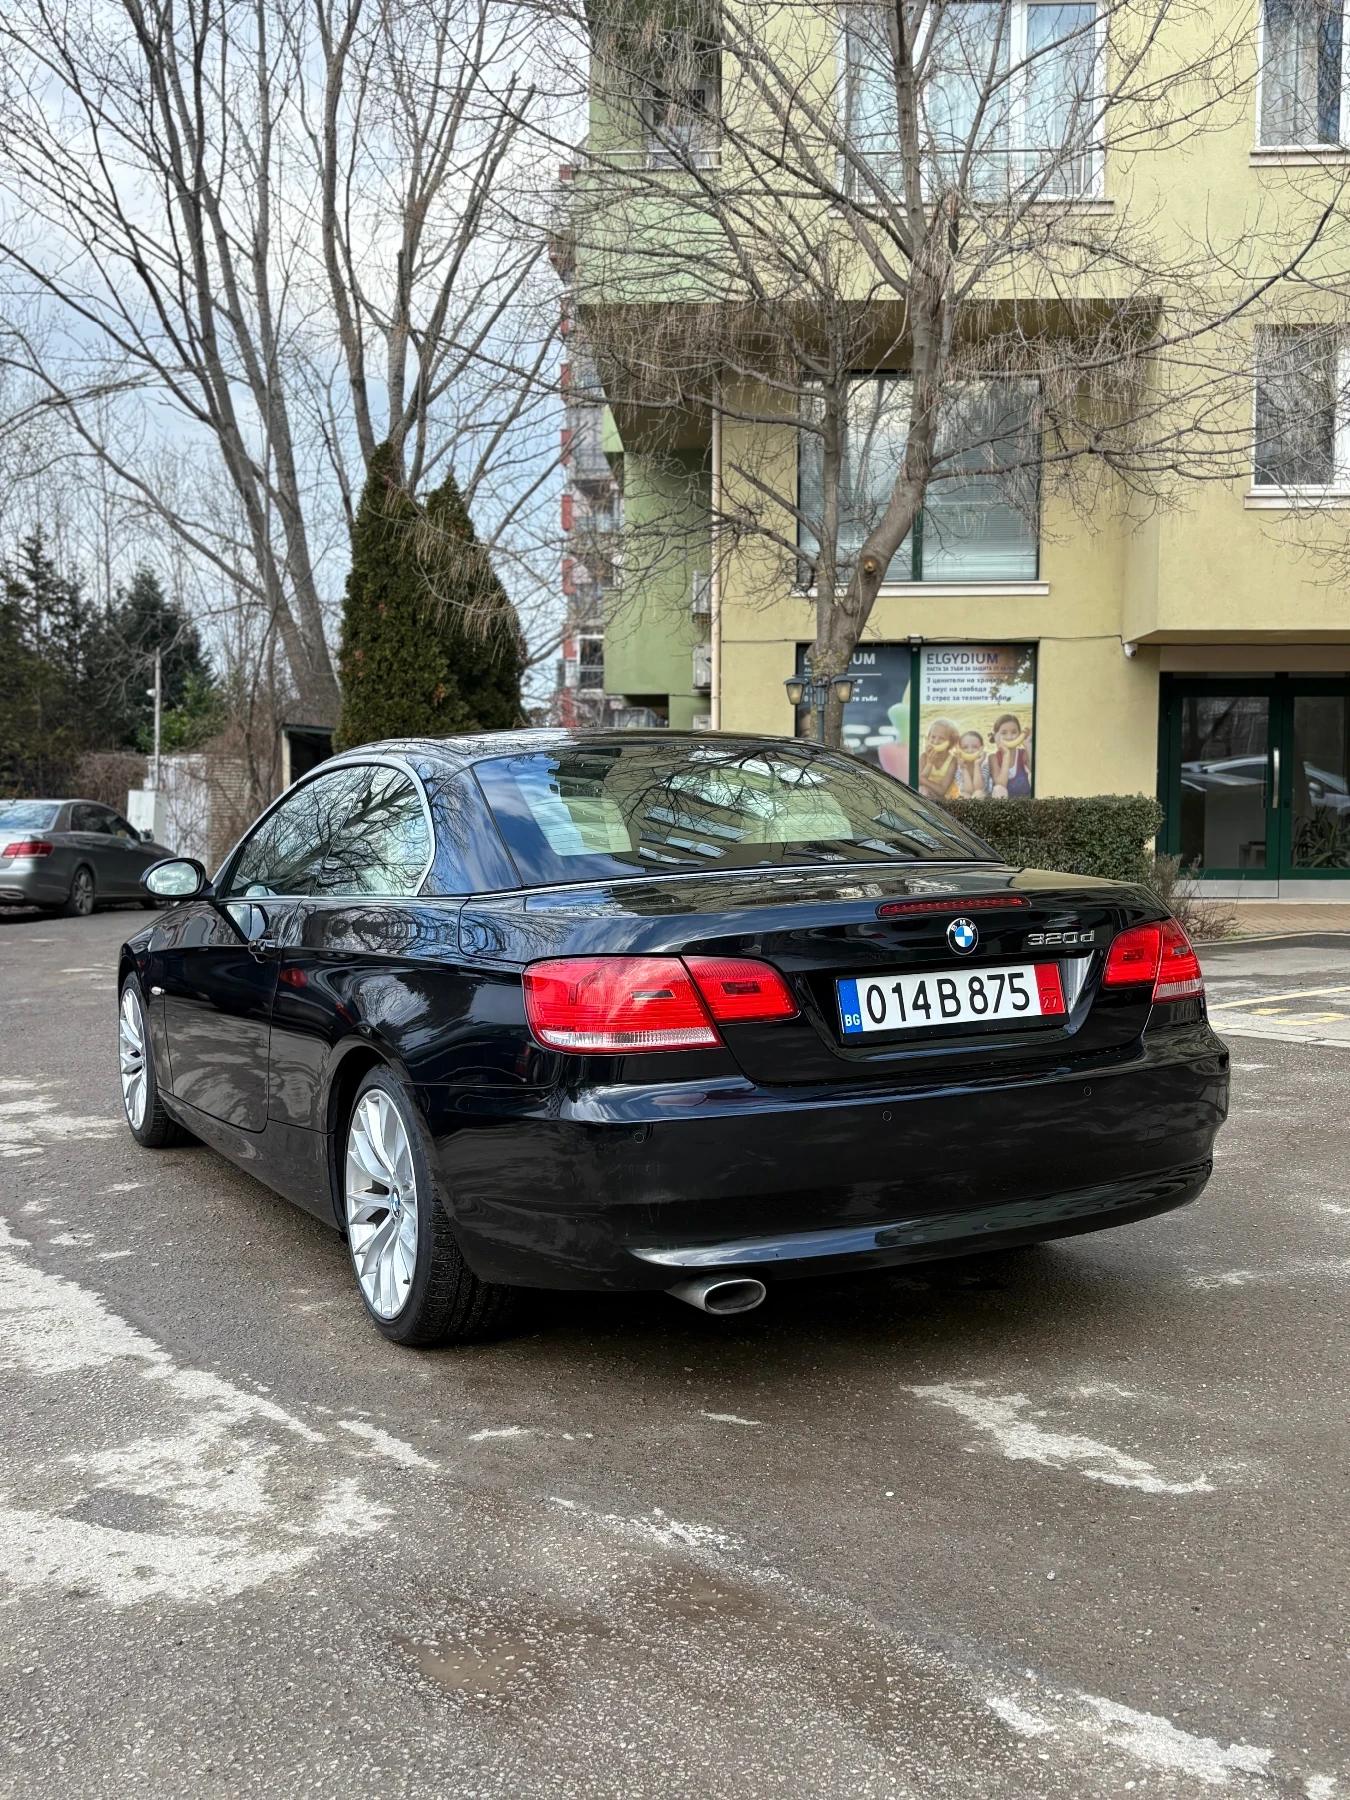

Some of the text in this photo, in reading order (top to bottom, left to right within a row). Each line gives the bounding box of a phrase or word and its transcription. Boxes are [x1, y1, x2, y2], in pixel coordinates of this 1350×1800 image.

[926, 653, 998, 664] ELGYDIUM
[950, 919, 976, 931] BMW
[1027, 930, 1095, 946] 320d
[1042, 995, 1058, 1009] 27
[844, 1014, 860, 1027] BG
